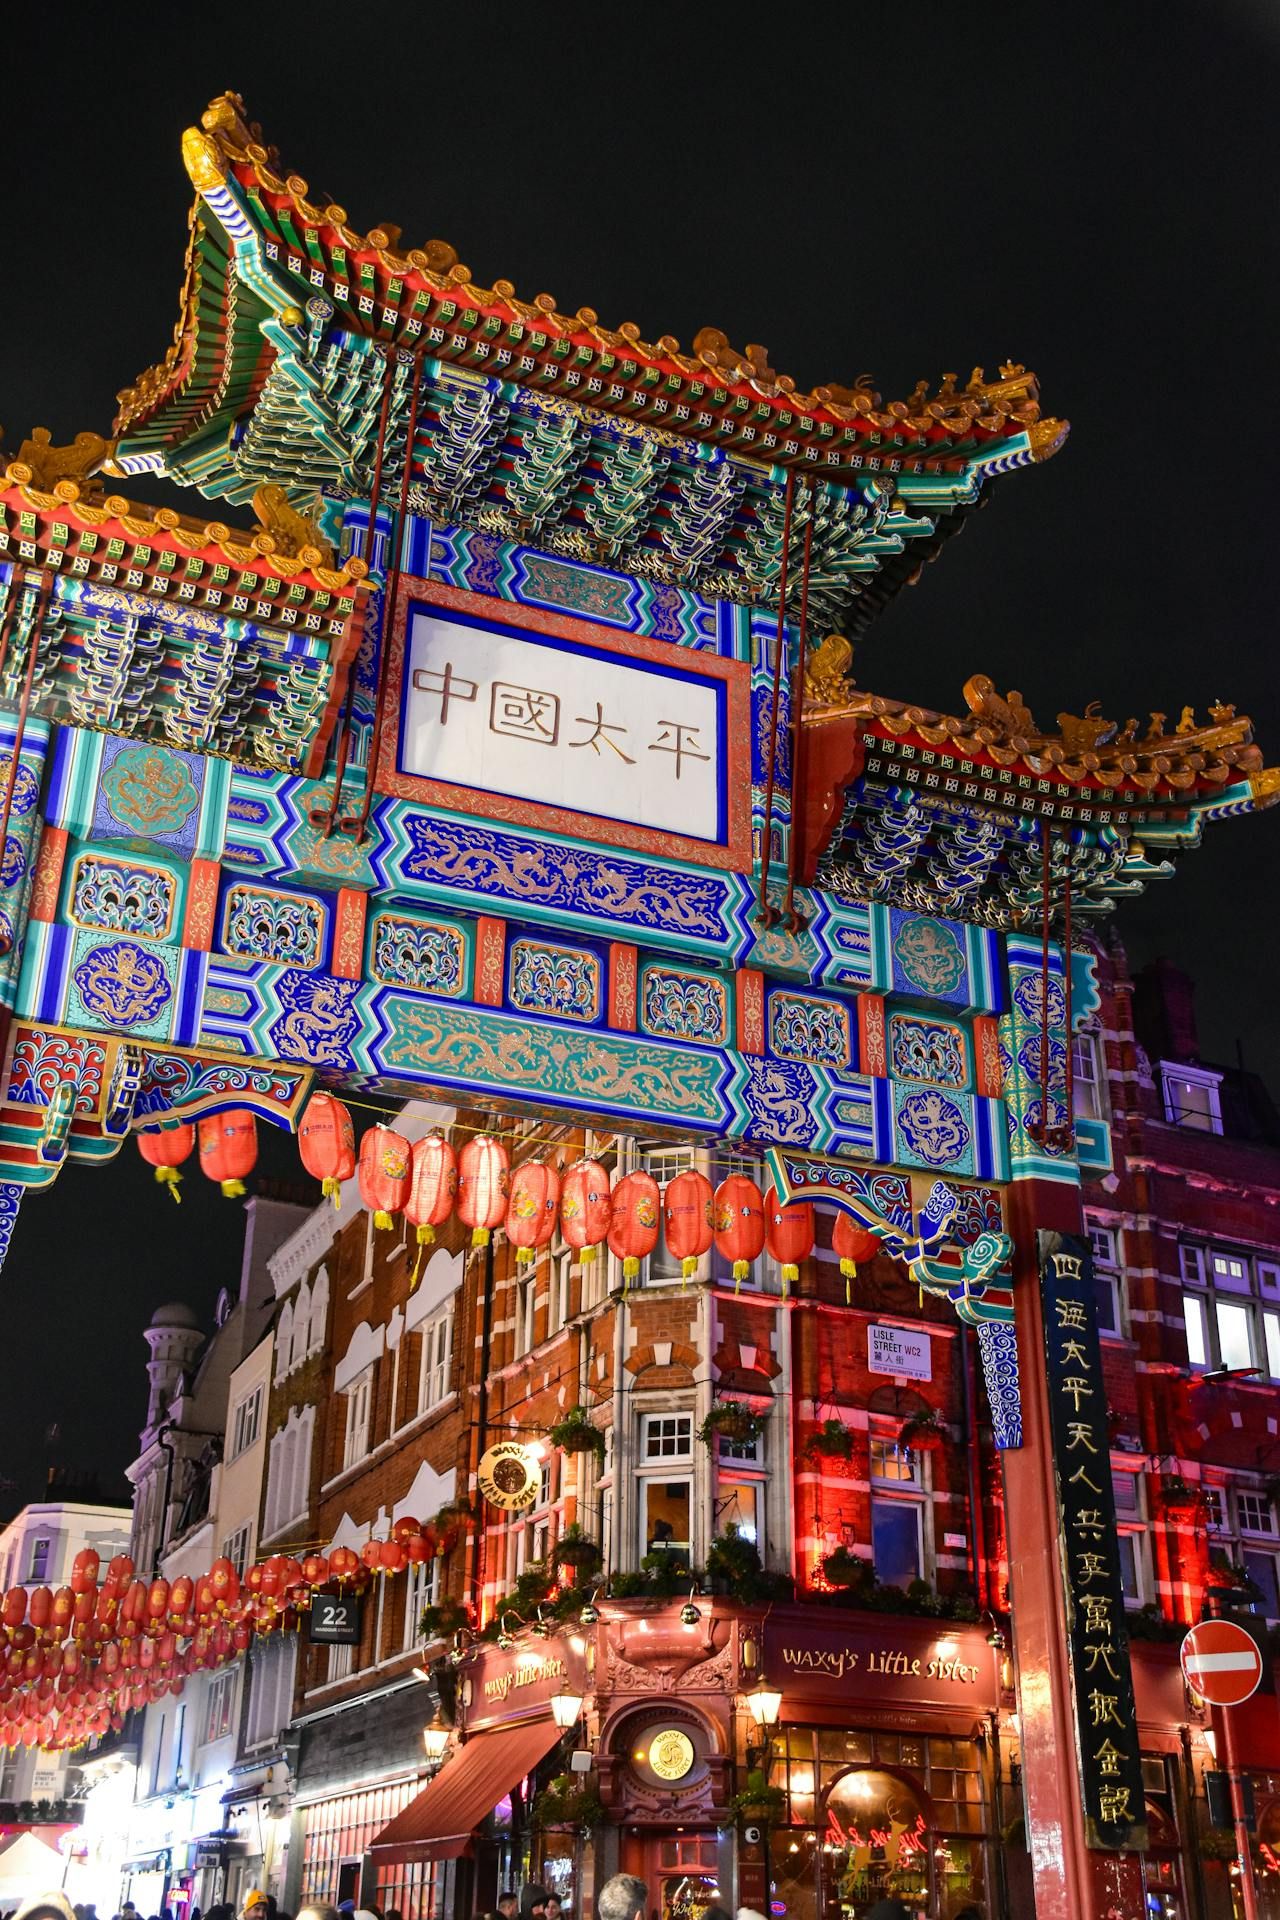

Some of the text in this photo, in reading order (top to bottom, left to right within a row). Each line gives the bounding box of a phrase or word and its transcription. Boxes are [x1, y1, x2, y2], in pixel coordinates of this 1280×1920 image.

[412, 662, 712, 779] 中國太平
[873, 1329, 895, 1341] LISLE
[873, 1341, 921, 1357] STREET WC2
[322, 1606, 347, 1625] 22
[927, 1656, 979, 1682] sister
